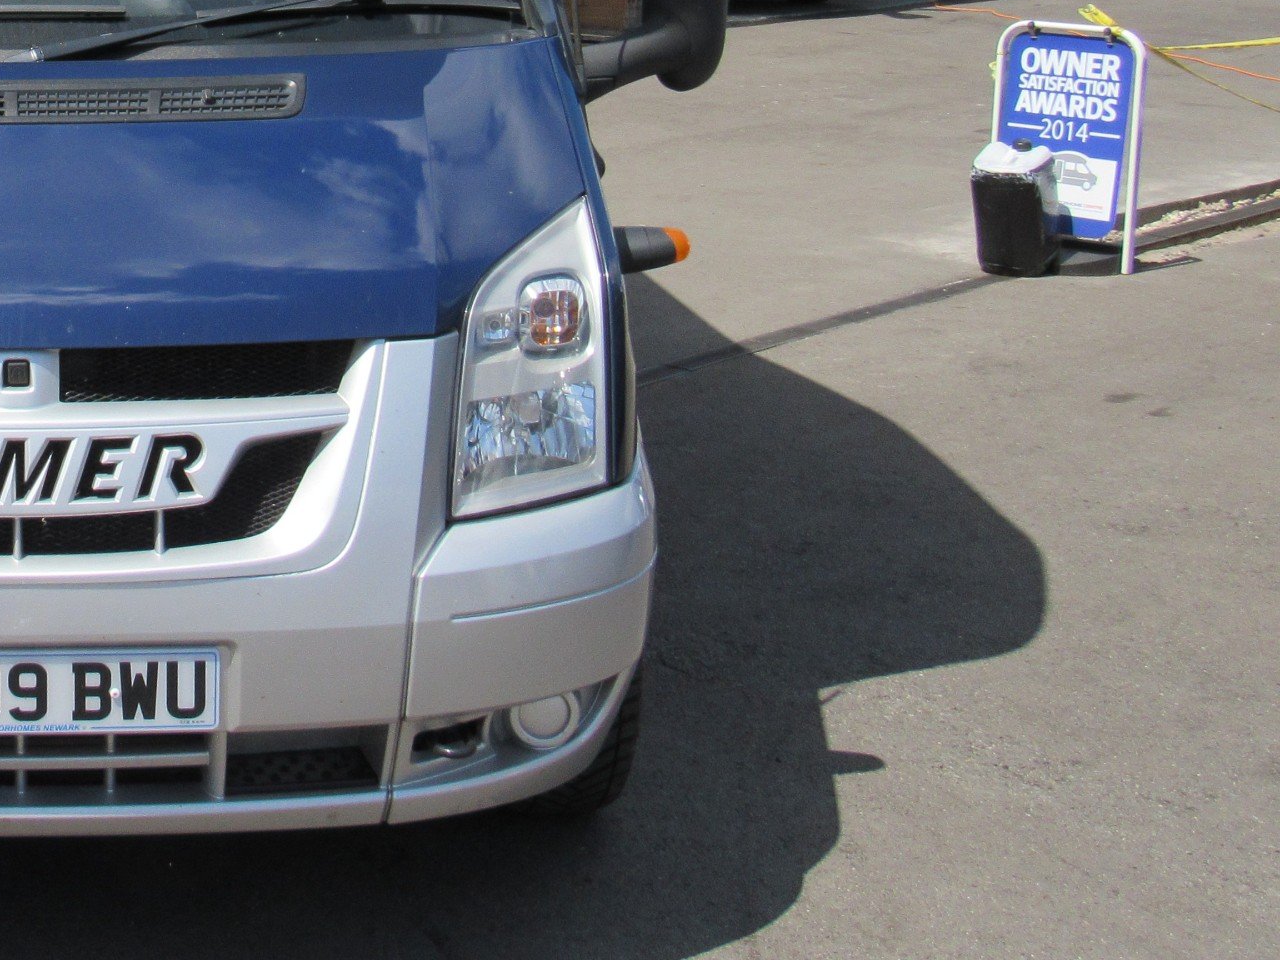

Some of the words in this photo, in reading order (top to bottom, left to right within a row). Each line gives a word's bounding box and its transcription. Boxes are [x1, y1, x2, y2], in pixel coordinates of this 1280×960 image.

[1021, 47, 1120, 81] OWNER
[1018, 73, 1119, 98] SATISFACTION
[1014, 89, 1118, 122] AWARDS
[1039, 118, 1089, 143] 2014
[72, 660, 206, 721] BWU
